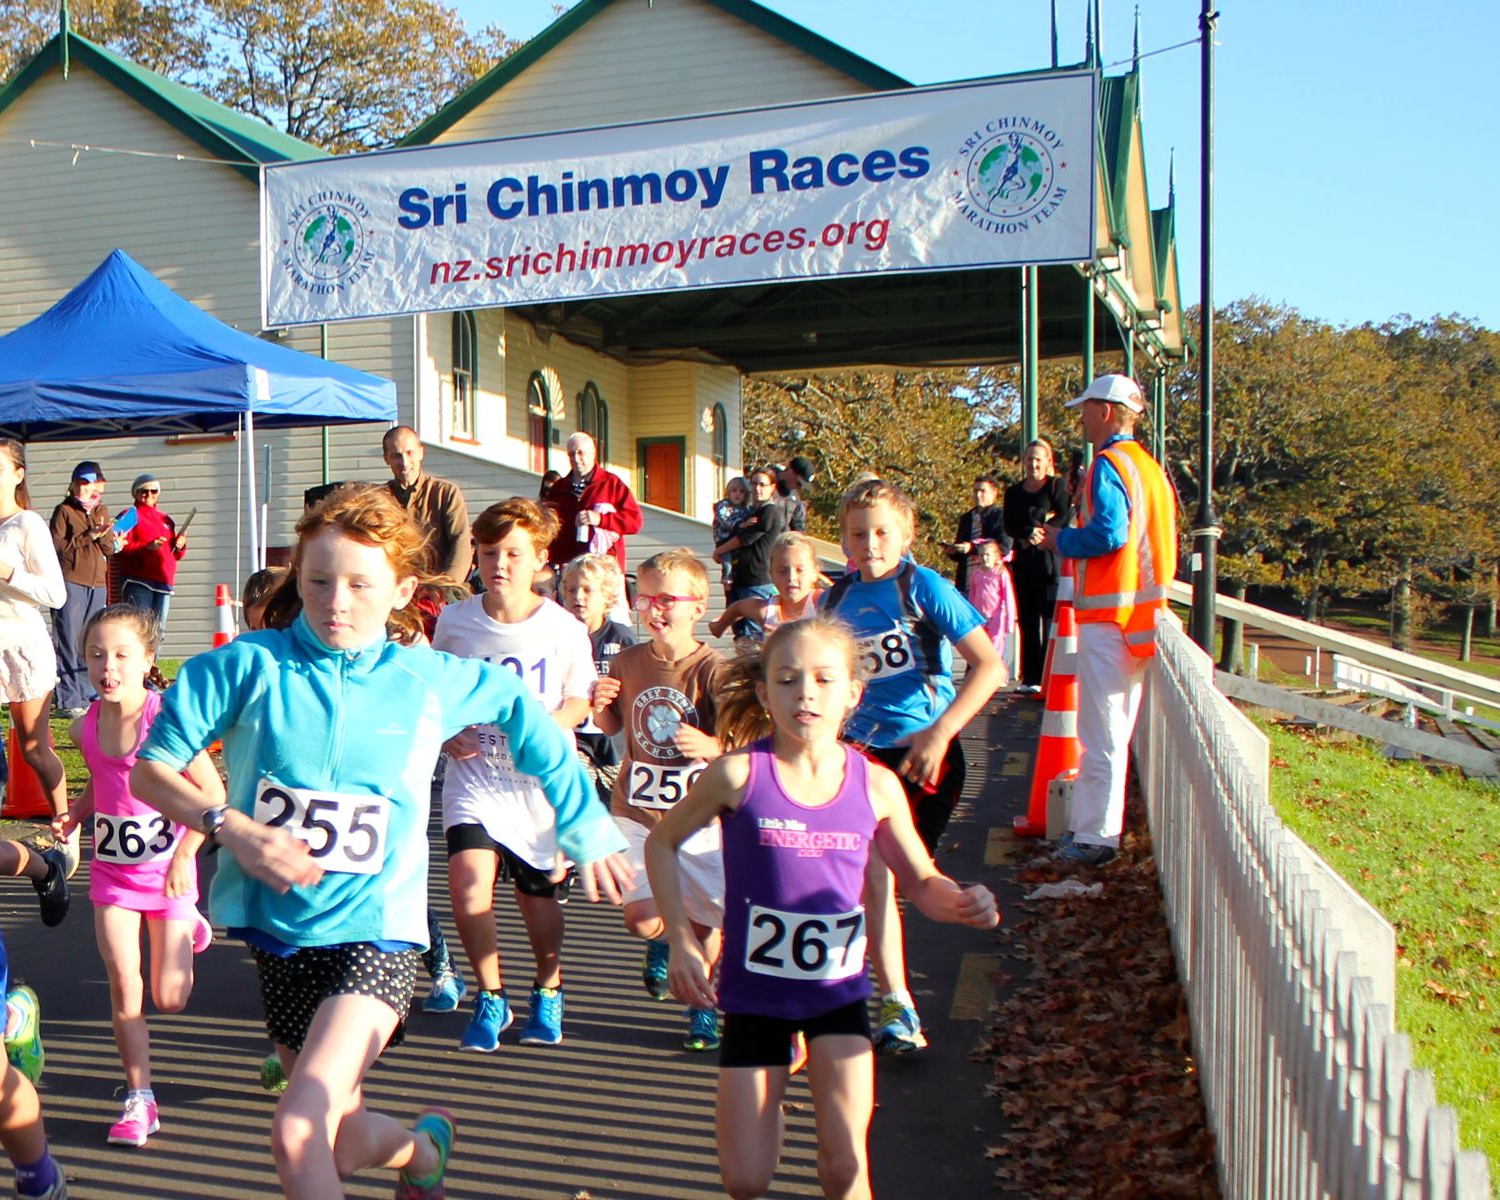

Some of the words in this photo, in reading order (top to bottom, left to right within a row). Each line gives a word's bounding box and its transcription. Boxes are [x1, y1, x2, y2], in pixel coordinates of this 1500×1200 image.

[959, 131, 982, 157] SRI
[986, 116, 1064, 150] CHINMOY
[287, 204, 306, 226] SRI
[308, 190, 372, 219] CHINMOY
[397, 183, 468, 230] Sri
[487, 165, 730, 220] Chinmoy
[749, 146, 931, 194] Races
[954, 190, 1029, 234] MARATHON
[1031, 187, 1067, 224] TEAM
[430, 218, 890, 284] nz.srichinmoyraces.org
[284, 257, 345, 295] MARATHON
[636, 731, 674, 757] SCHO
[632, 766, 700, 803] 25
[96, 816, 175, 858] 263
[260, 787, 381, 863] 255
[758, 829, 861, 851] ENERGETIC
[748, 913, 863, 973] 267
